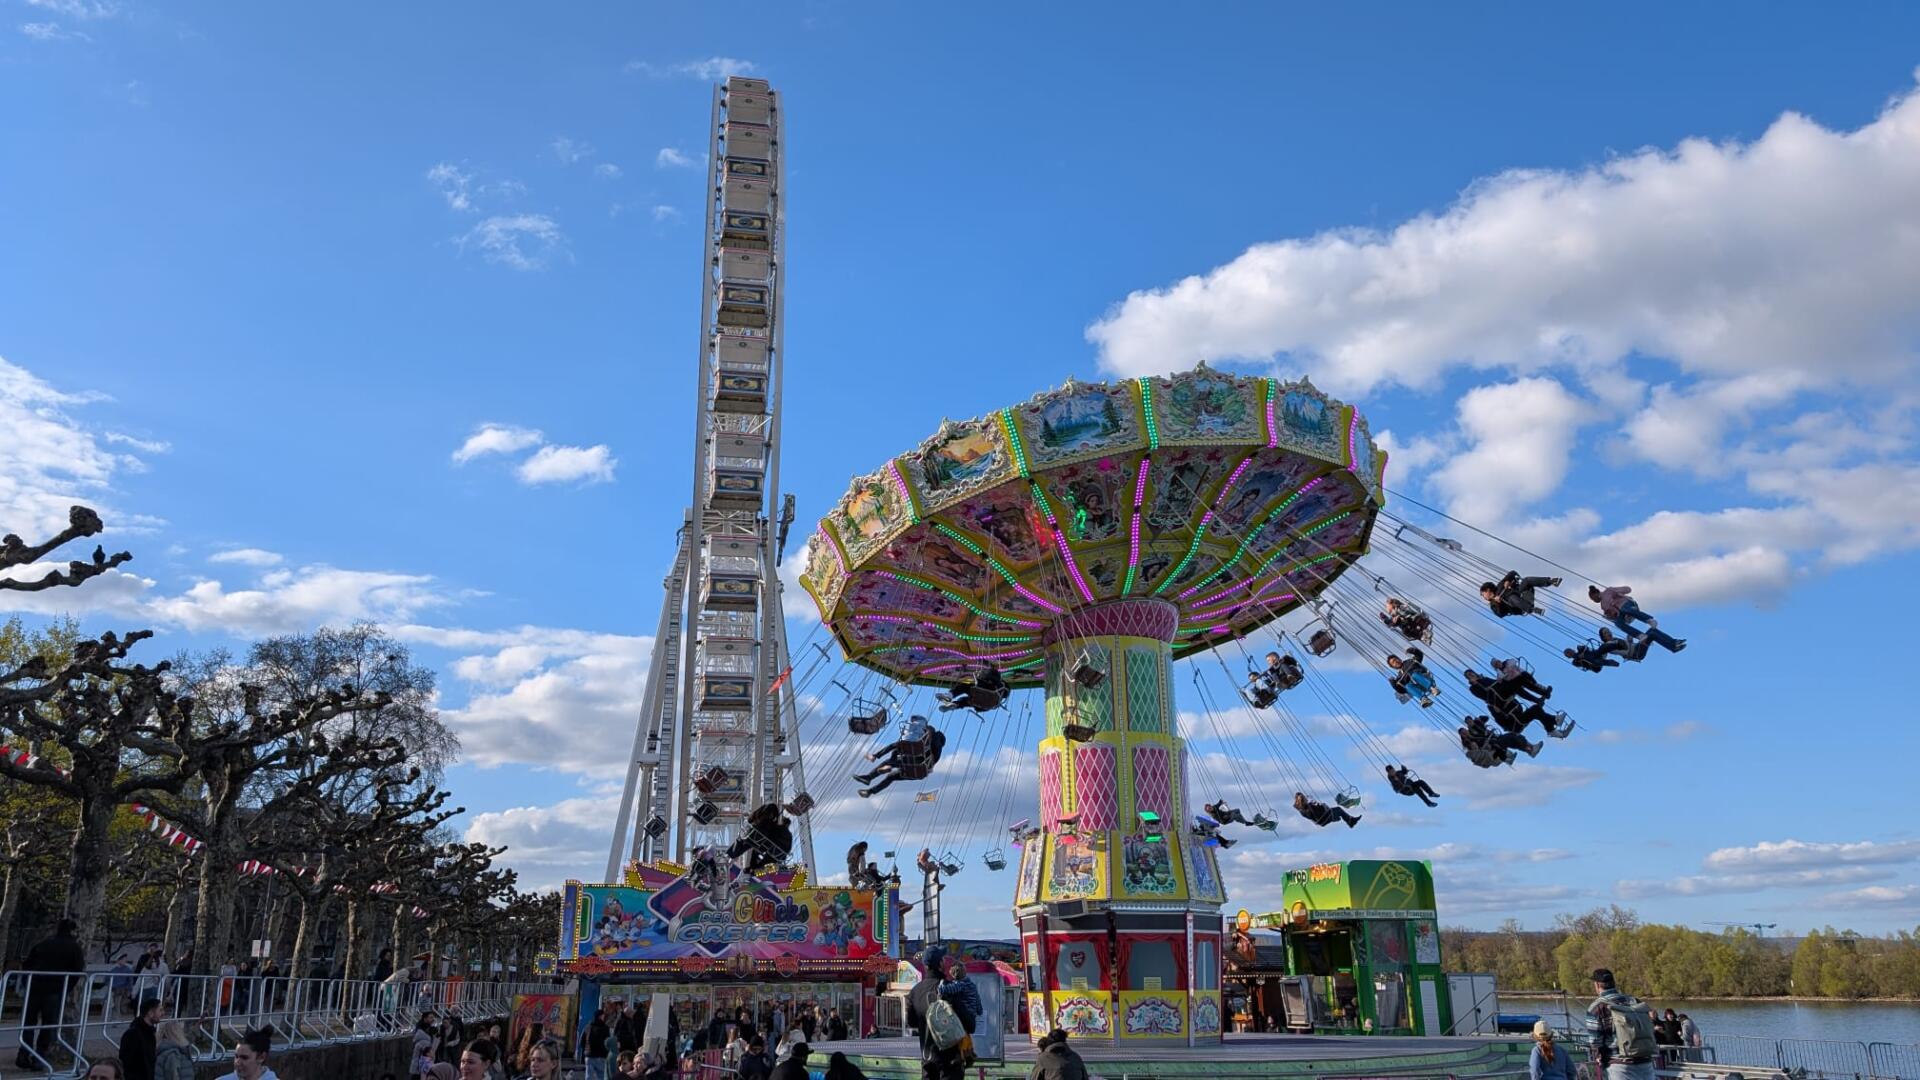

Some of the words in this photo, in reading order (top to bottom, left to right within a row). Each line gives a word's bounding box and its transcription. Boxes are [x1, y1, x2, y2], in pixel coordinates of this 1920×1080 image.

[700, 911, 731, 924] DER
[735, 891, 809, 924] Glücks
[678, 924, 808, 942] GREIFER
